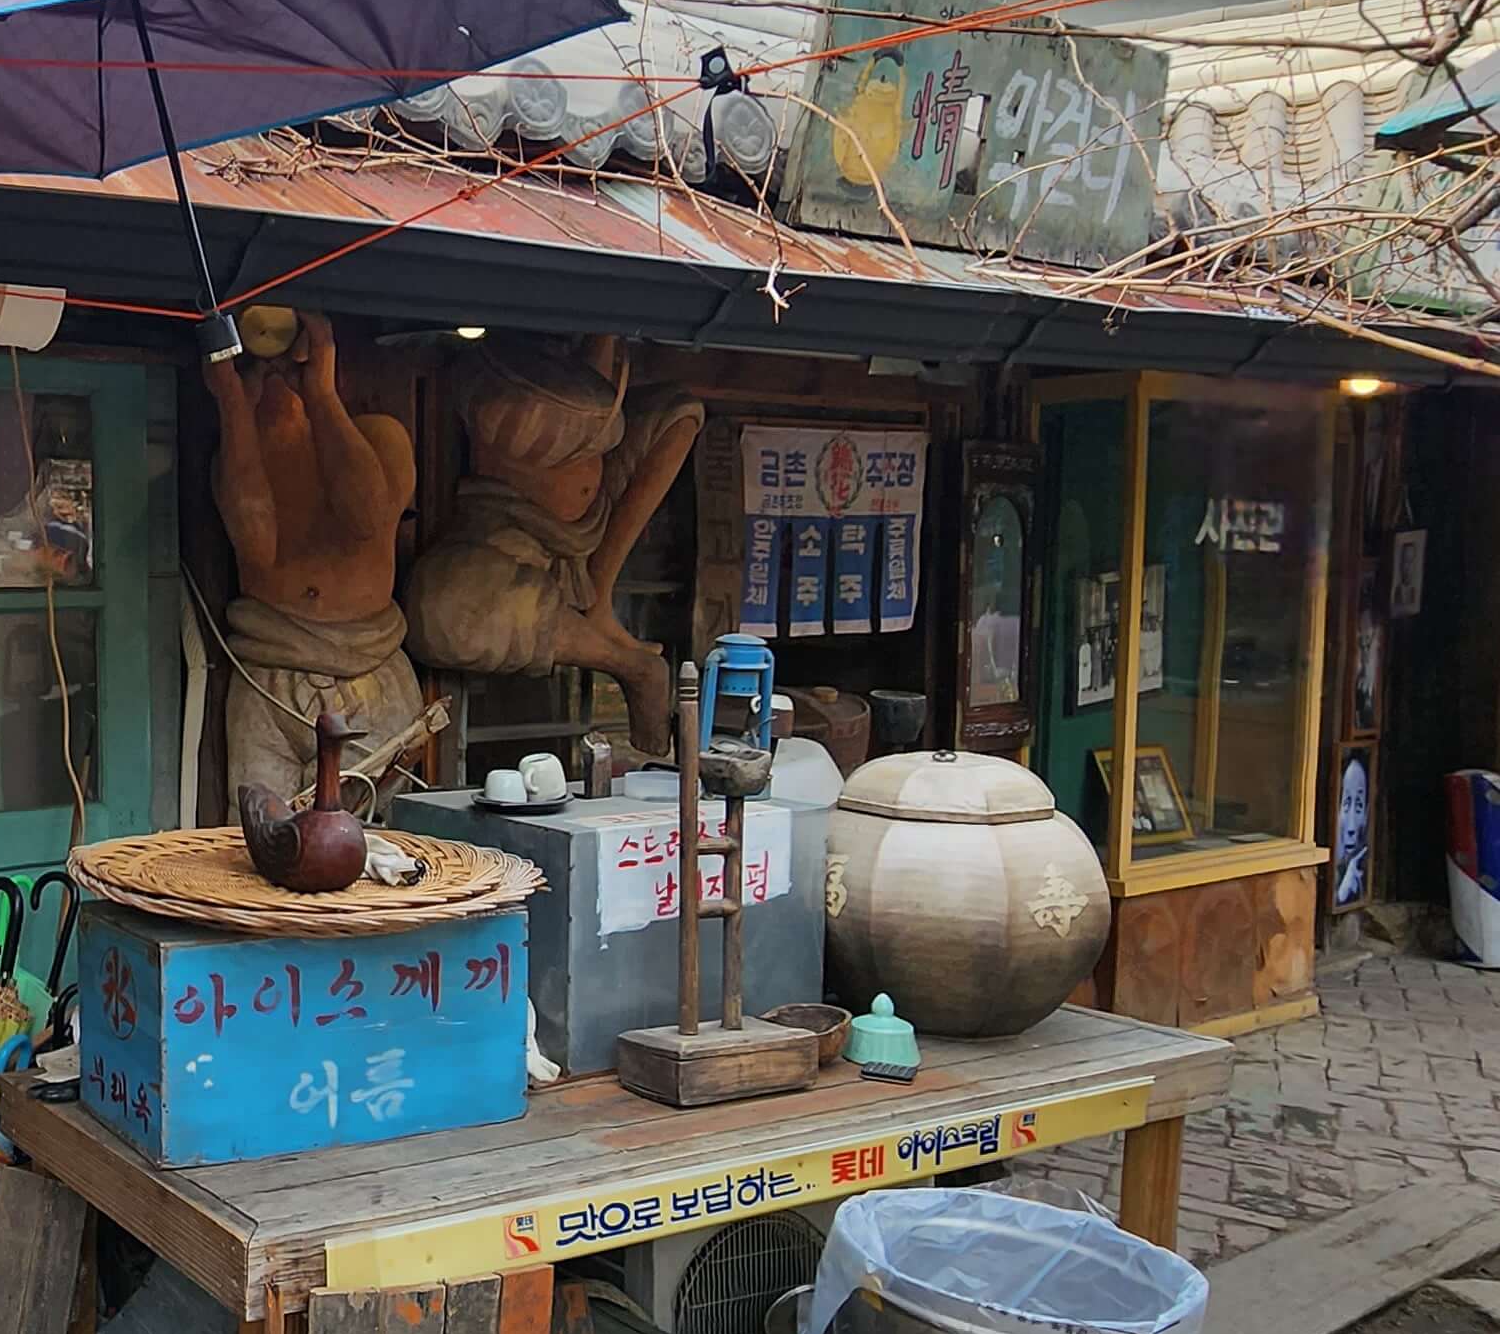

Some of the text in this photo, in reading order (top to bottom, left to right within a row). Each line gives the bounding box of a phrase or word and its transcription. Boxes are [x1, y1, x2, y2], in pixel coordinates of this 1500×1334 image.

[910, 48, 973, 191] 情
[987, 67, 1138, 225] 막걸리
[760, 449, 808, 488] 금촌
[866, 452, 916, 488] 주조장
[745, 519, 778, 606] 안주일체
[1195, 498, 1285, 553] 사진관
[172, 942, 512, 1038] 아이스께끼
[289, 1048, 415, 1129] 어름
[556, 1197, 664, 1247] 맛으로
[831, 1145, 885, 1186] 롯데
[897, 1113, 1002, 1171] 아이스크림
